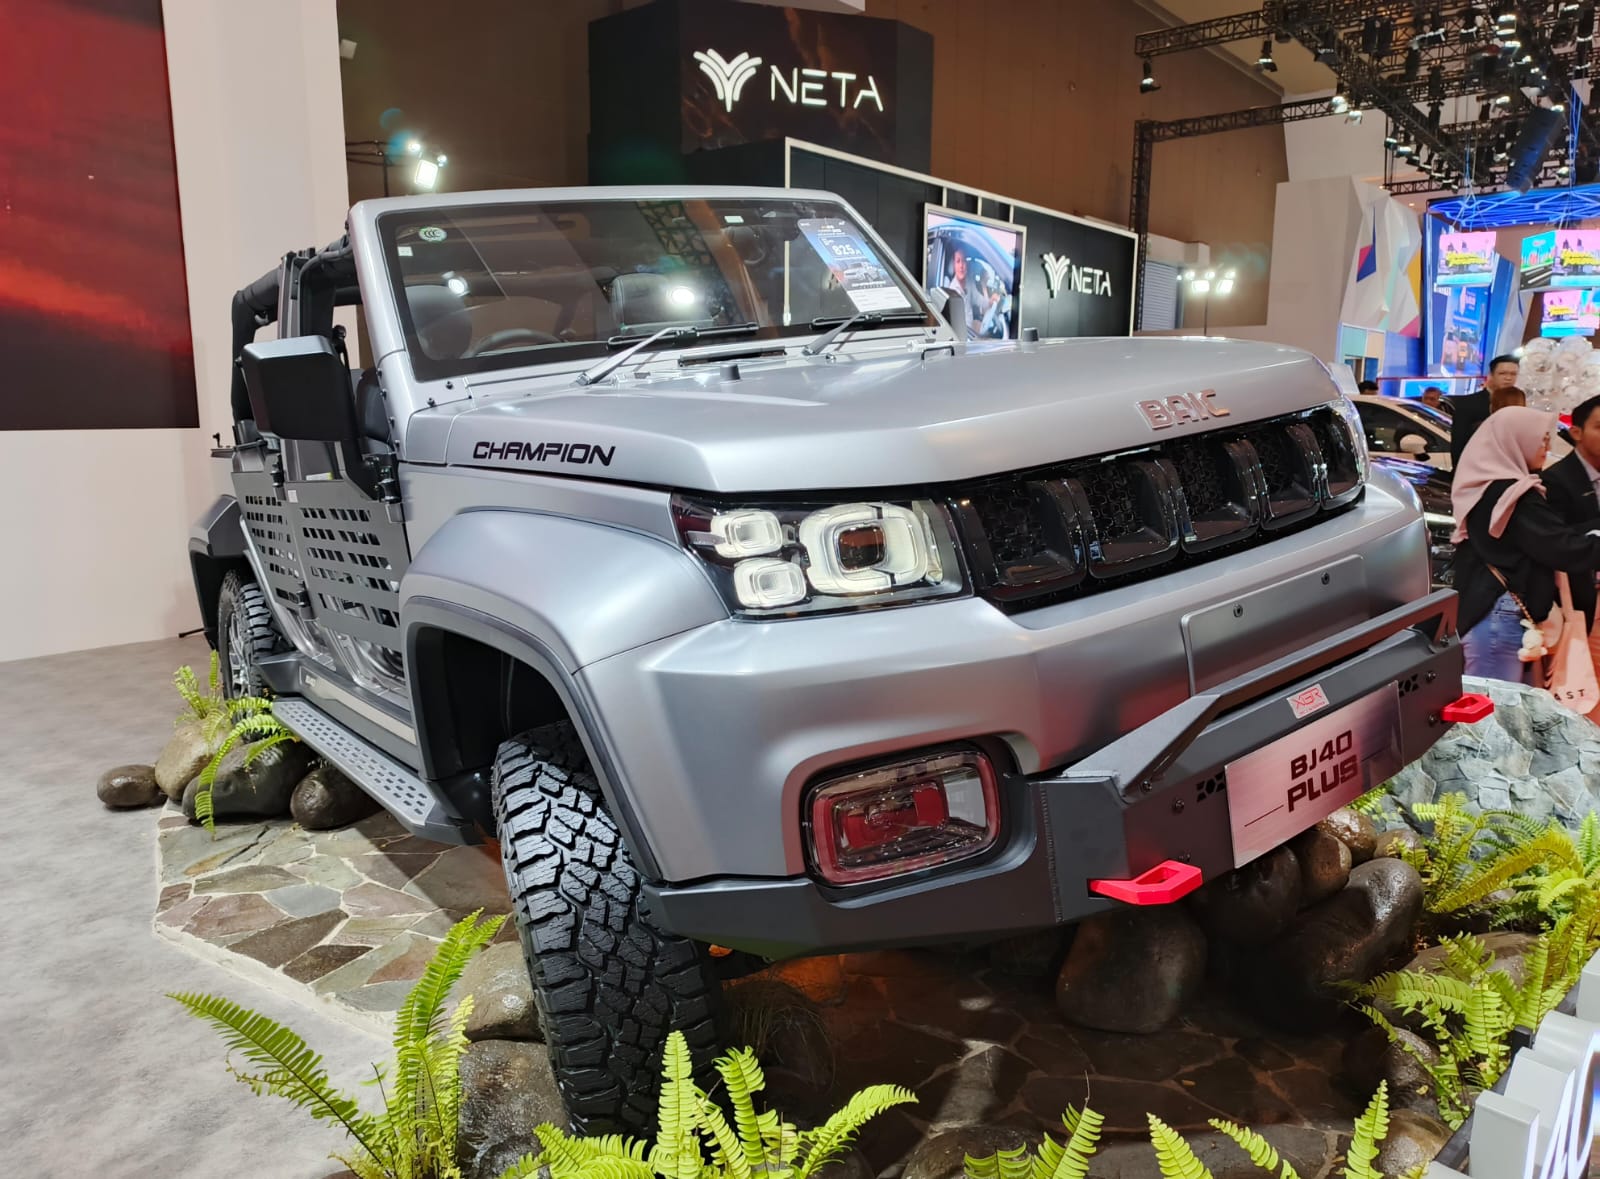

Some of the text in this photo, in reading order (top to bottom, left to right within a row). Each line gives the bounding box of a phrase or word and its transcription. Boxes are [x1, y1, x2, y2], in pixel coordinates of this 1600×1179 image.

[770, 65, 884, 112] NETA
[832, 244, 855, 256] 825
[1070, 264, 1112, 297] NETA
[1136, 389, 1231, 431] BAIC
[472, 441, 616, 467] CHAMPION
[1290, 729, 1353, 781] BJ40
[1287, 754, 1358, 813] PLUS
